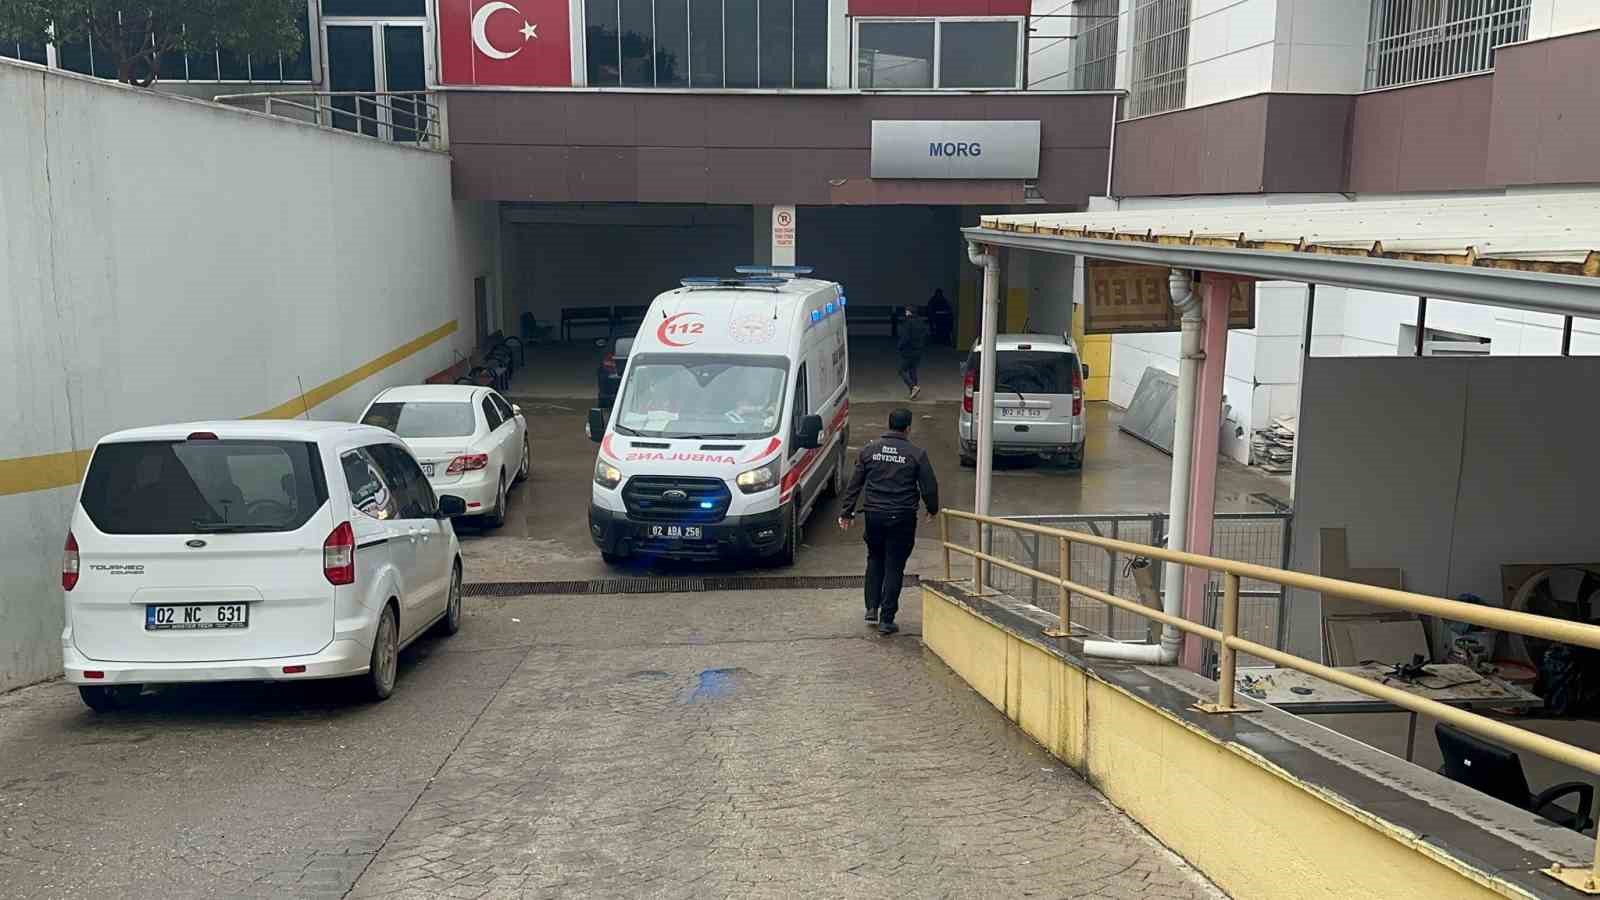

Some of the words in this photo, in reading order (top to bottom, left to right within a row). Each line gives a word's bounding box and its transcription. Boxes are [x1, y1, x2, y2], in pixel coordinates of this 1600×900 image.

[929, 142, 982, 157] MORG
[668, 323, 704, 335] 112
[652, 525, 663, 536] 02
[156, 608, 174, 624] 02
[184, 607, 202, 623] NC
[217, 606, 241, 622] 631
